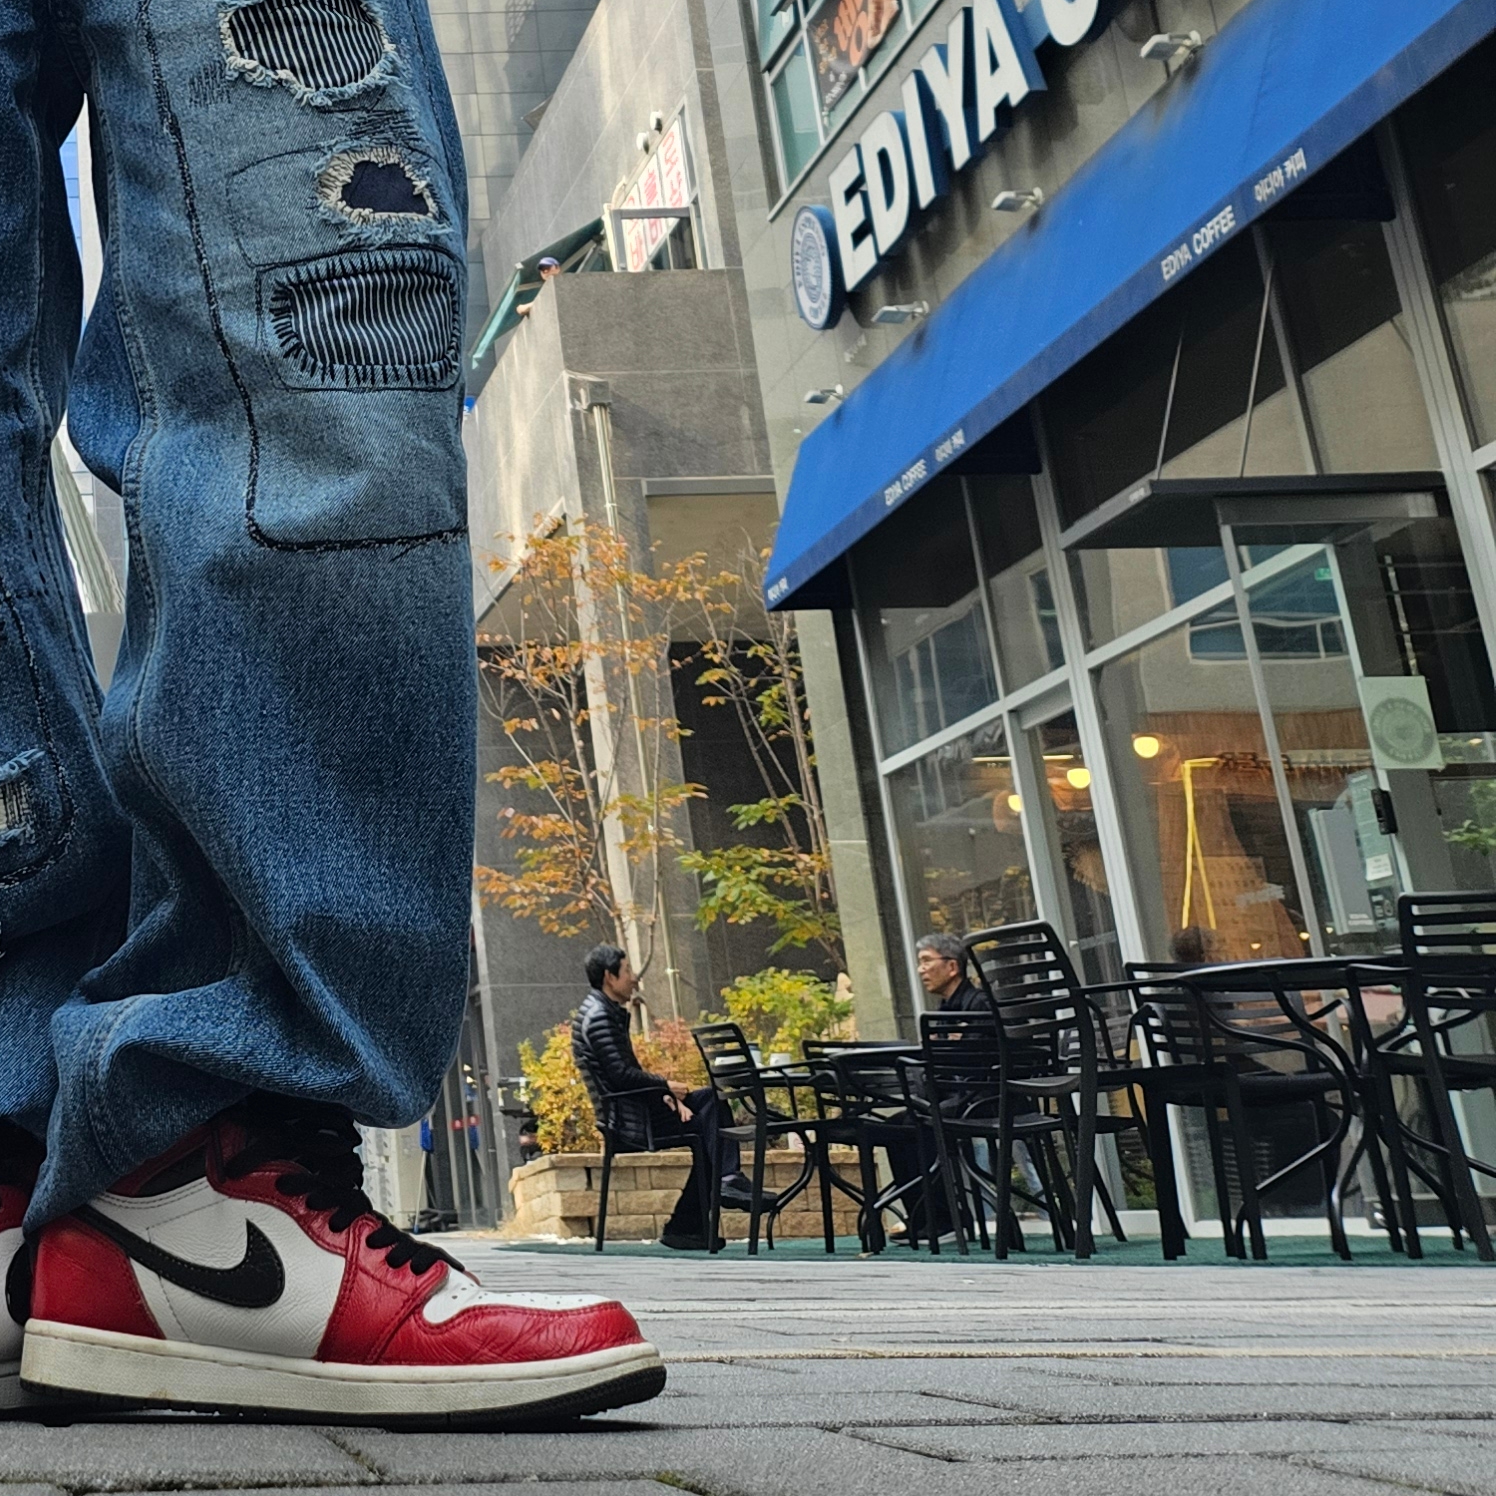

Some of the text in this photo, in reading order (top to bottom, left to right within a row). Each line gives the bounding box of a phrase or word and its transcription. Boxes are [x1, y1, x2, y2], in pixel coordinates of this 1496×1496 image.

[1283, 147, 1307, 179] 커피
[1161, 205, 1236, 281] EDIYA COFFEE
